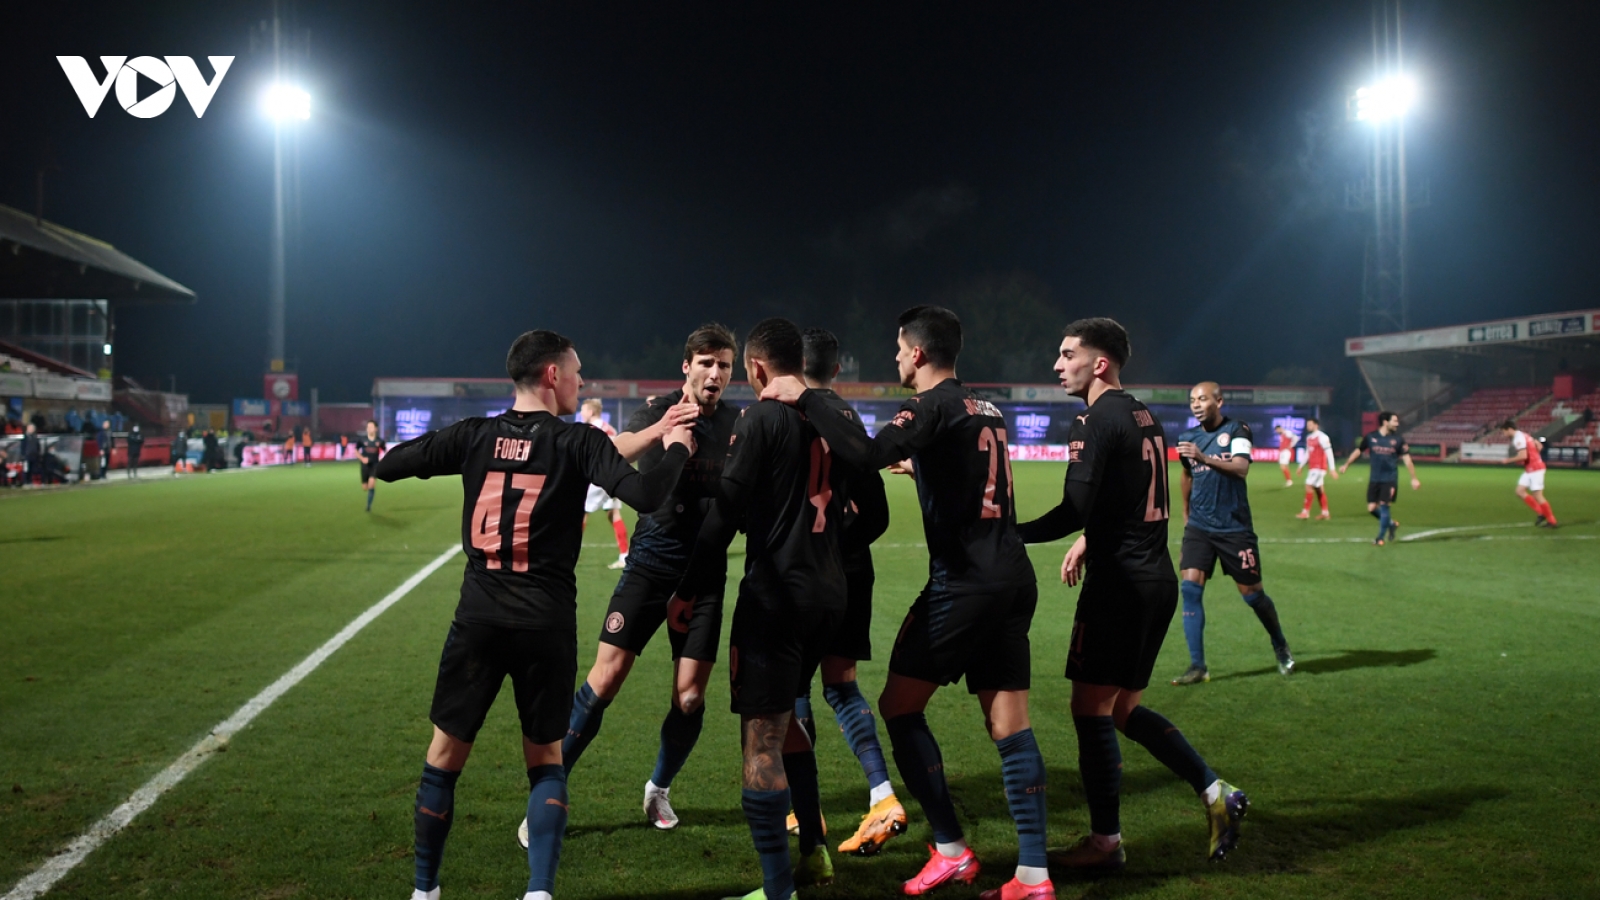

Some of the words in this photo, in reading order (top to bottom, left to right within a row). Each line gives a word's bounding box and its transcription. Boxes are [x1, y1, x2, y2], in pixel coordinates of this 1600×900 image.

[494, 437, 532, 461] FODEN
[978, 426, 1013, 519] 27
[1141, 435, 1169, 522] 21
[471, 471, 547, 572] 47
[1238, 548, 1257, 570] 25
